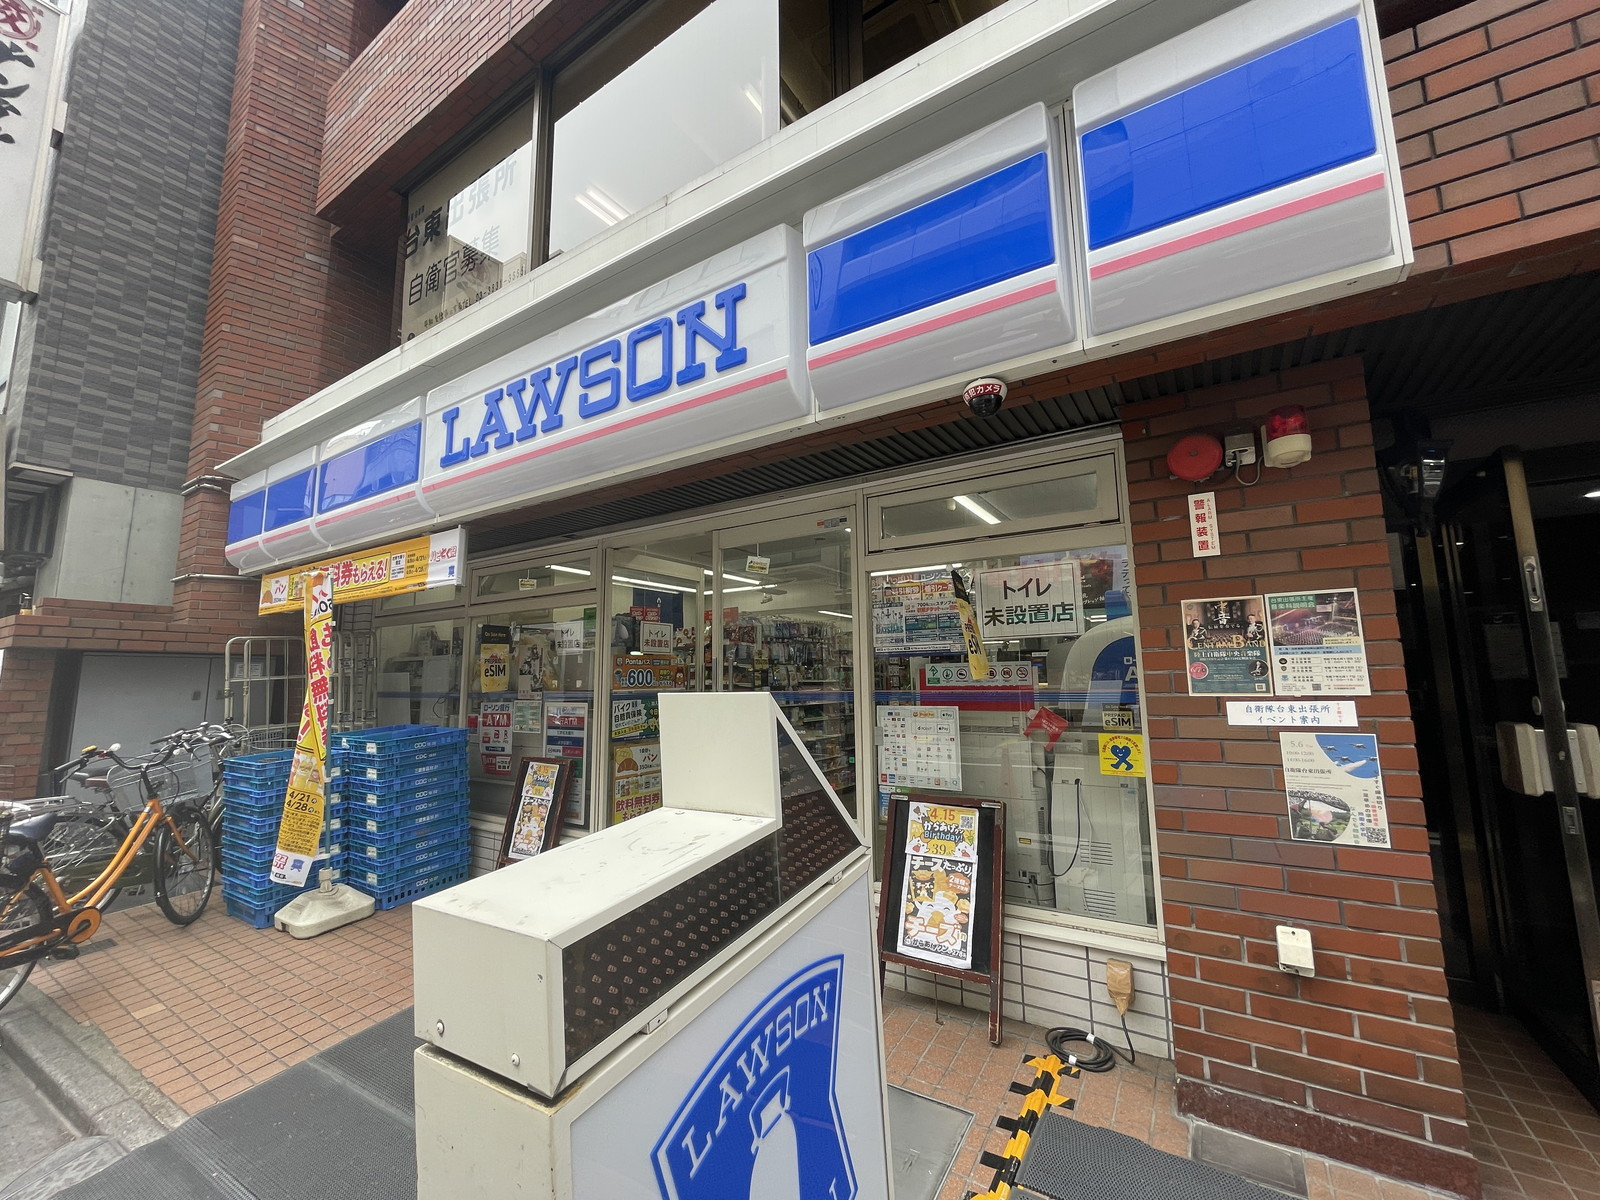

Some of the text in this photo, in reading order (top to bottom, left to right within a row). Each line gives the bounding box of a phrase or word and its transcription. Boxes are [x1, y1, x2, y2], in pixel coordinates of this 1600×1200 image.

[409, 225, 501, 306] 自衛官募集
[440, 282, 747, 469] LAWSON
[1194, 499, 1209, 551] 警報装置
[1003, 578, 1052, 599] トイレ
[984, 602, 1074, 627] 未設置店
[648, 630, 667, 638] トイレ
[1231, 634, 1266, 649] BAND
[484, 665, 506, 678] eSIM
[627, 668, 653, 687] 600
[1245, 704, 1331, 714] 自衛隊台東出張所
[486, 714, 508, 726] ATM
[1105, 718, 1131, 727] eSIM
[1257, 715, 1321, 725] イベント案内
[643, 753, 658, 762] パン
[1285, 767, 1332, 775] 自衛隊台東出張所
[616, 792, 660, 812] 飲料無料券
[930, 808, 956, 821] 4.15
[924, 821, 964, 835] からあげクン
[924, 830, 963, 842] Birthday!
[905, 915, 962, 946] チーズ
[682, 982, 831, 1180] LAWSON
